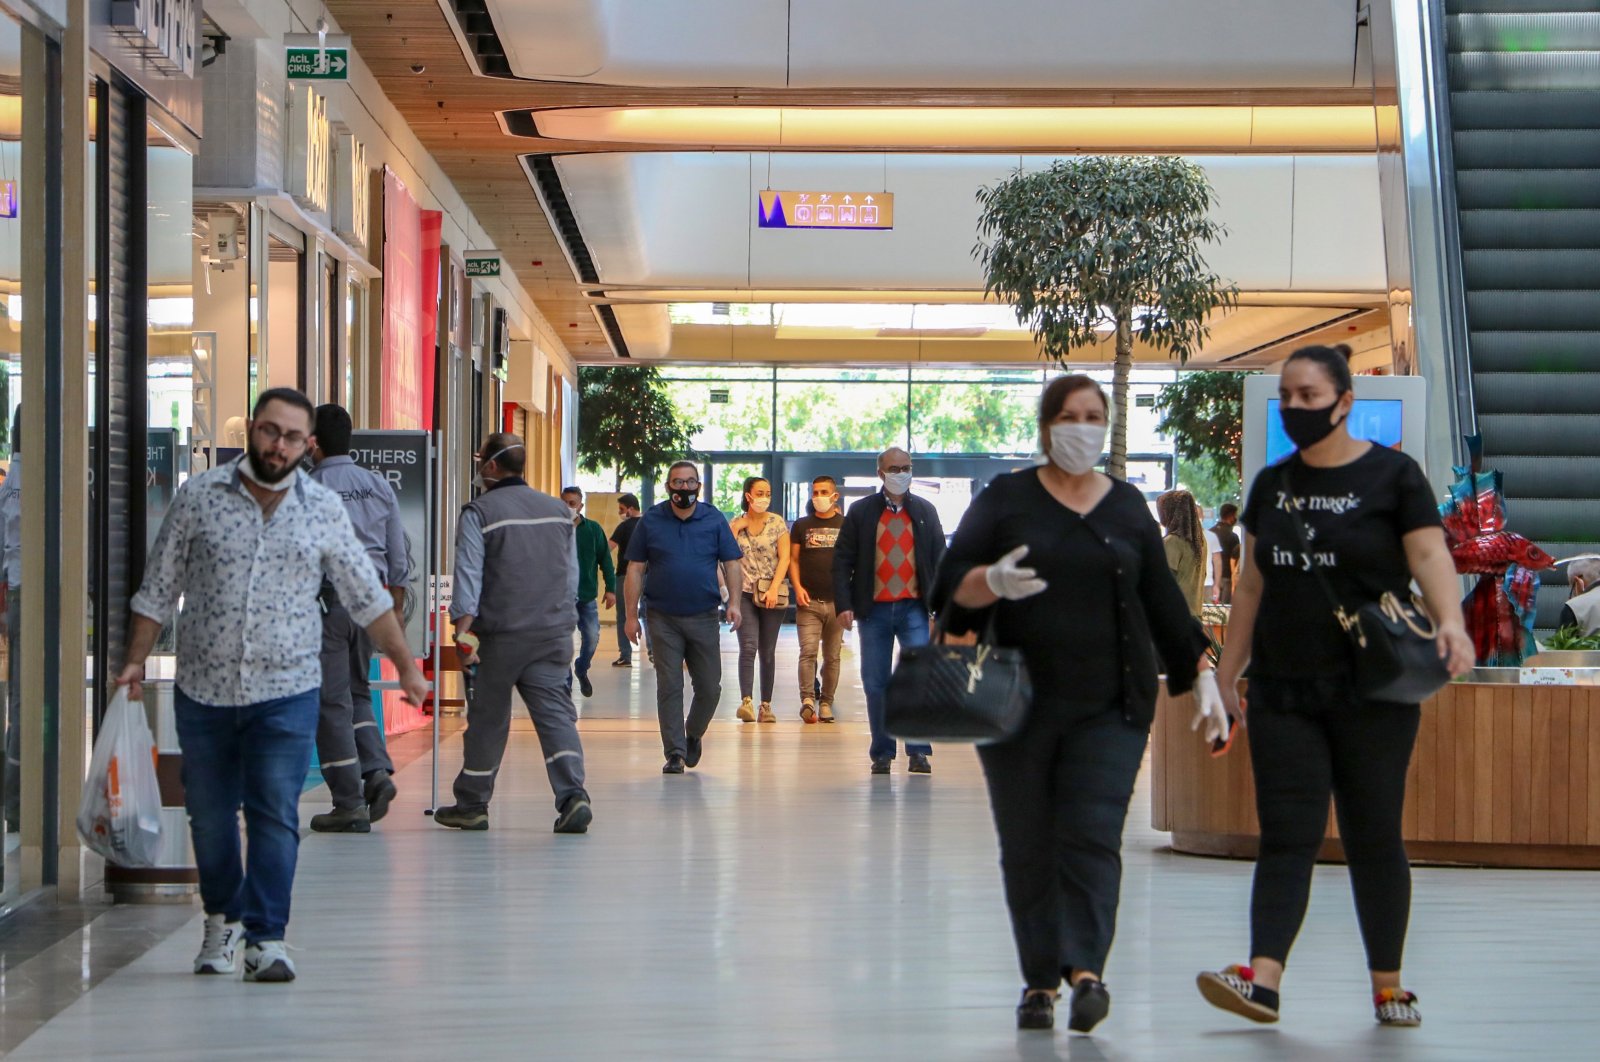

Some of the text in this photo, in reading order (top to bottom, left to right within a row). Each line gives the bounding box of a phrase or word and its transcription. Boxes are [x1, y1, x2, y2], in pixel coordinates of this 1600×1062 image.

[289, 53, 309, 63] ACİL
[288, 64, 311, 74] ÇIKIŞ
[348, 448, 416, 464] OTHERS
[1309, 492, 1361, 514] magic
[1273, 545, 1294, 565] in
